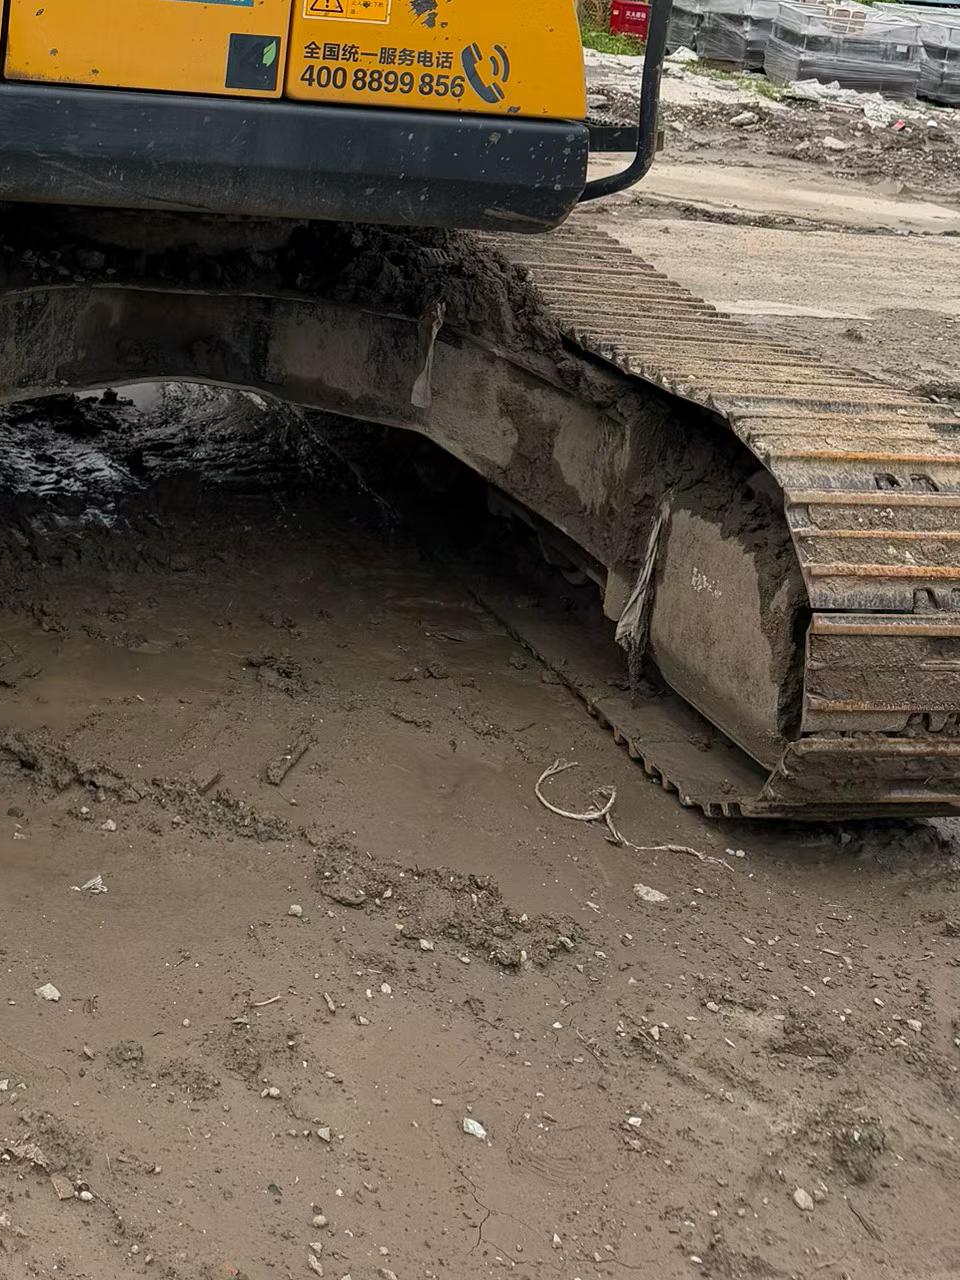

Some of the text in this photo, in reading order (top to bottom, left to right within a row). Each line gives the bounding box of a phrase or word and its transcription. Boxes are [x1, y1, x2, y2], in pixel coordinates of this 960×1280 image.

[303, 40, 454, 70] 全国统一服务电话
[300, 64, 466, 98] 400 8899 856
